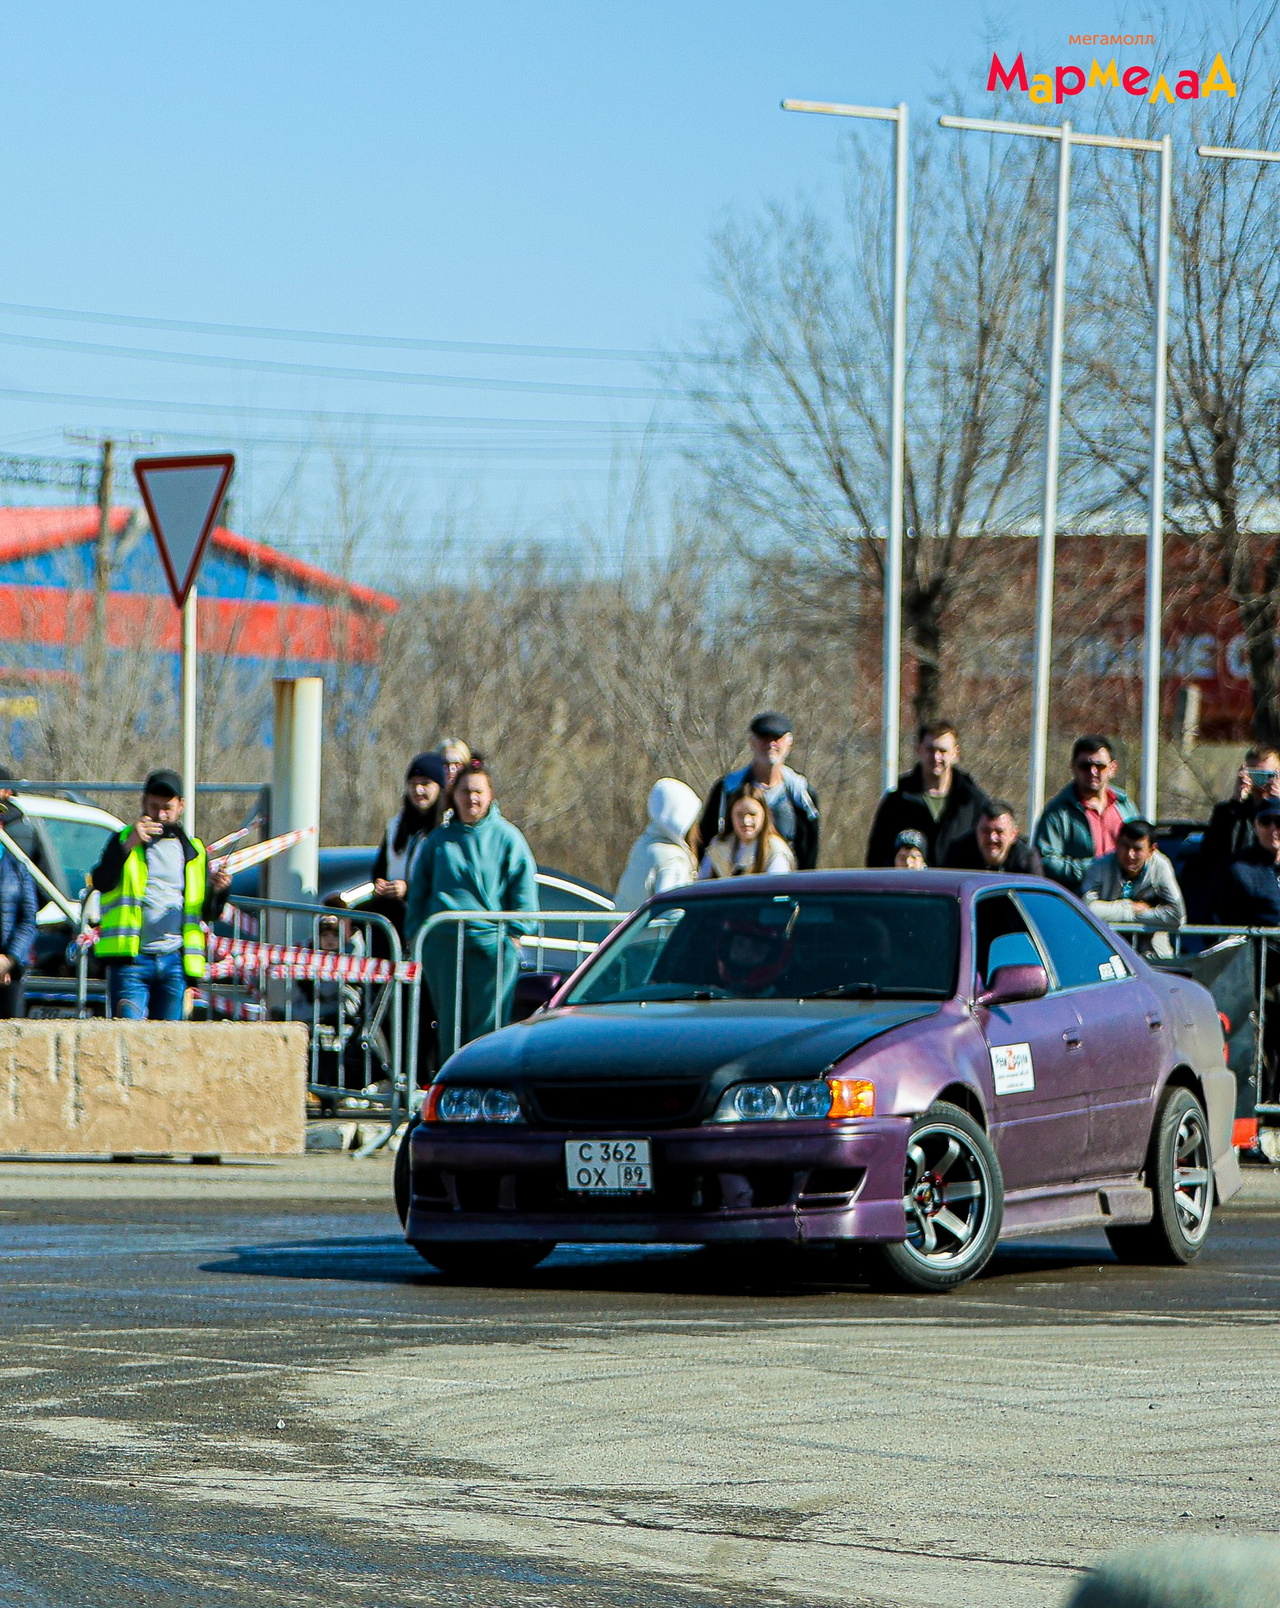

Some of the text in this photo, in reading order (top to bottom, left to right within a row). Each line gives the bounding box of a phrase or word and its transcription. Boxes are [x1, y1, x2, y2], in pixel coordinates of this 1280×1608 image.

[579, 1143, 637, 1161] С 362
[577, 1166, 643, 1187] ОХ 89
